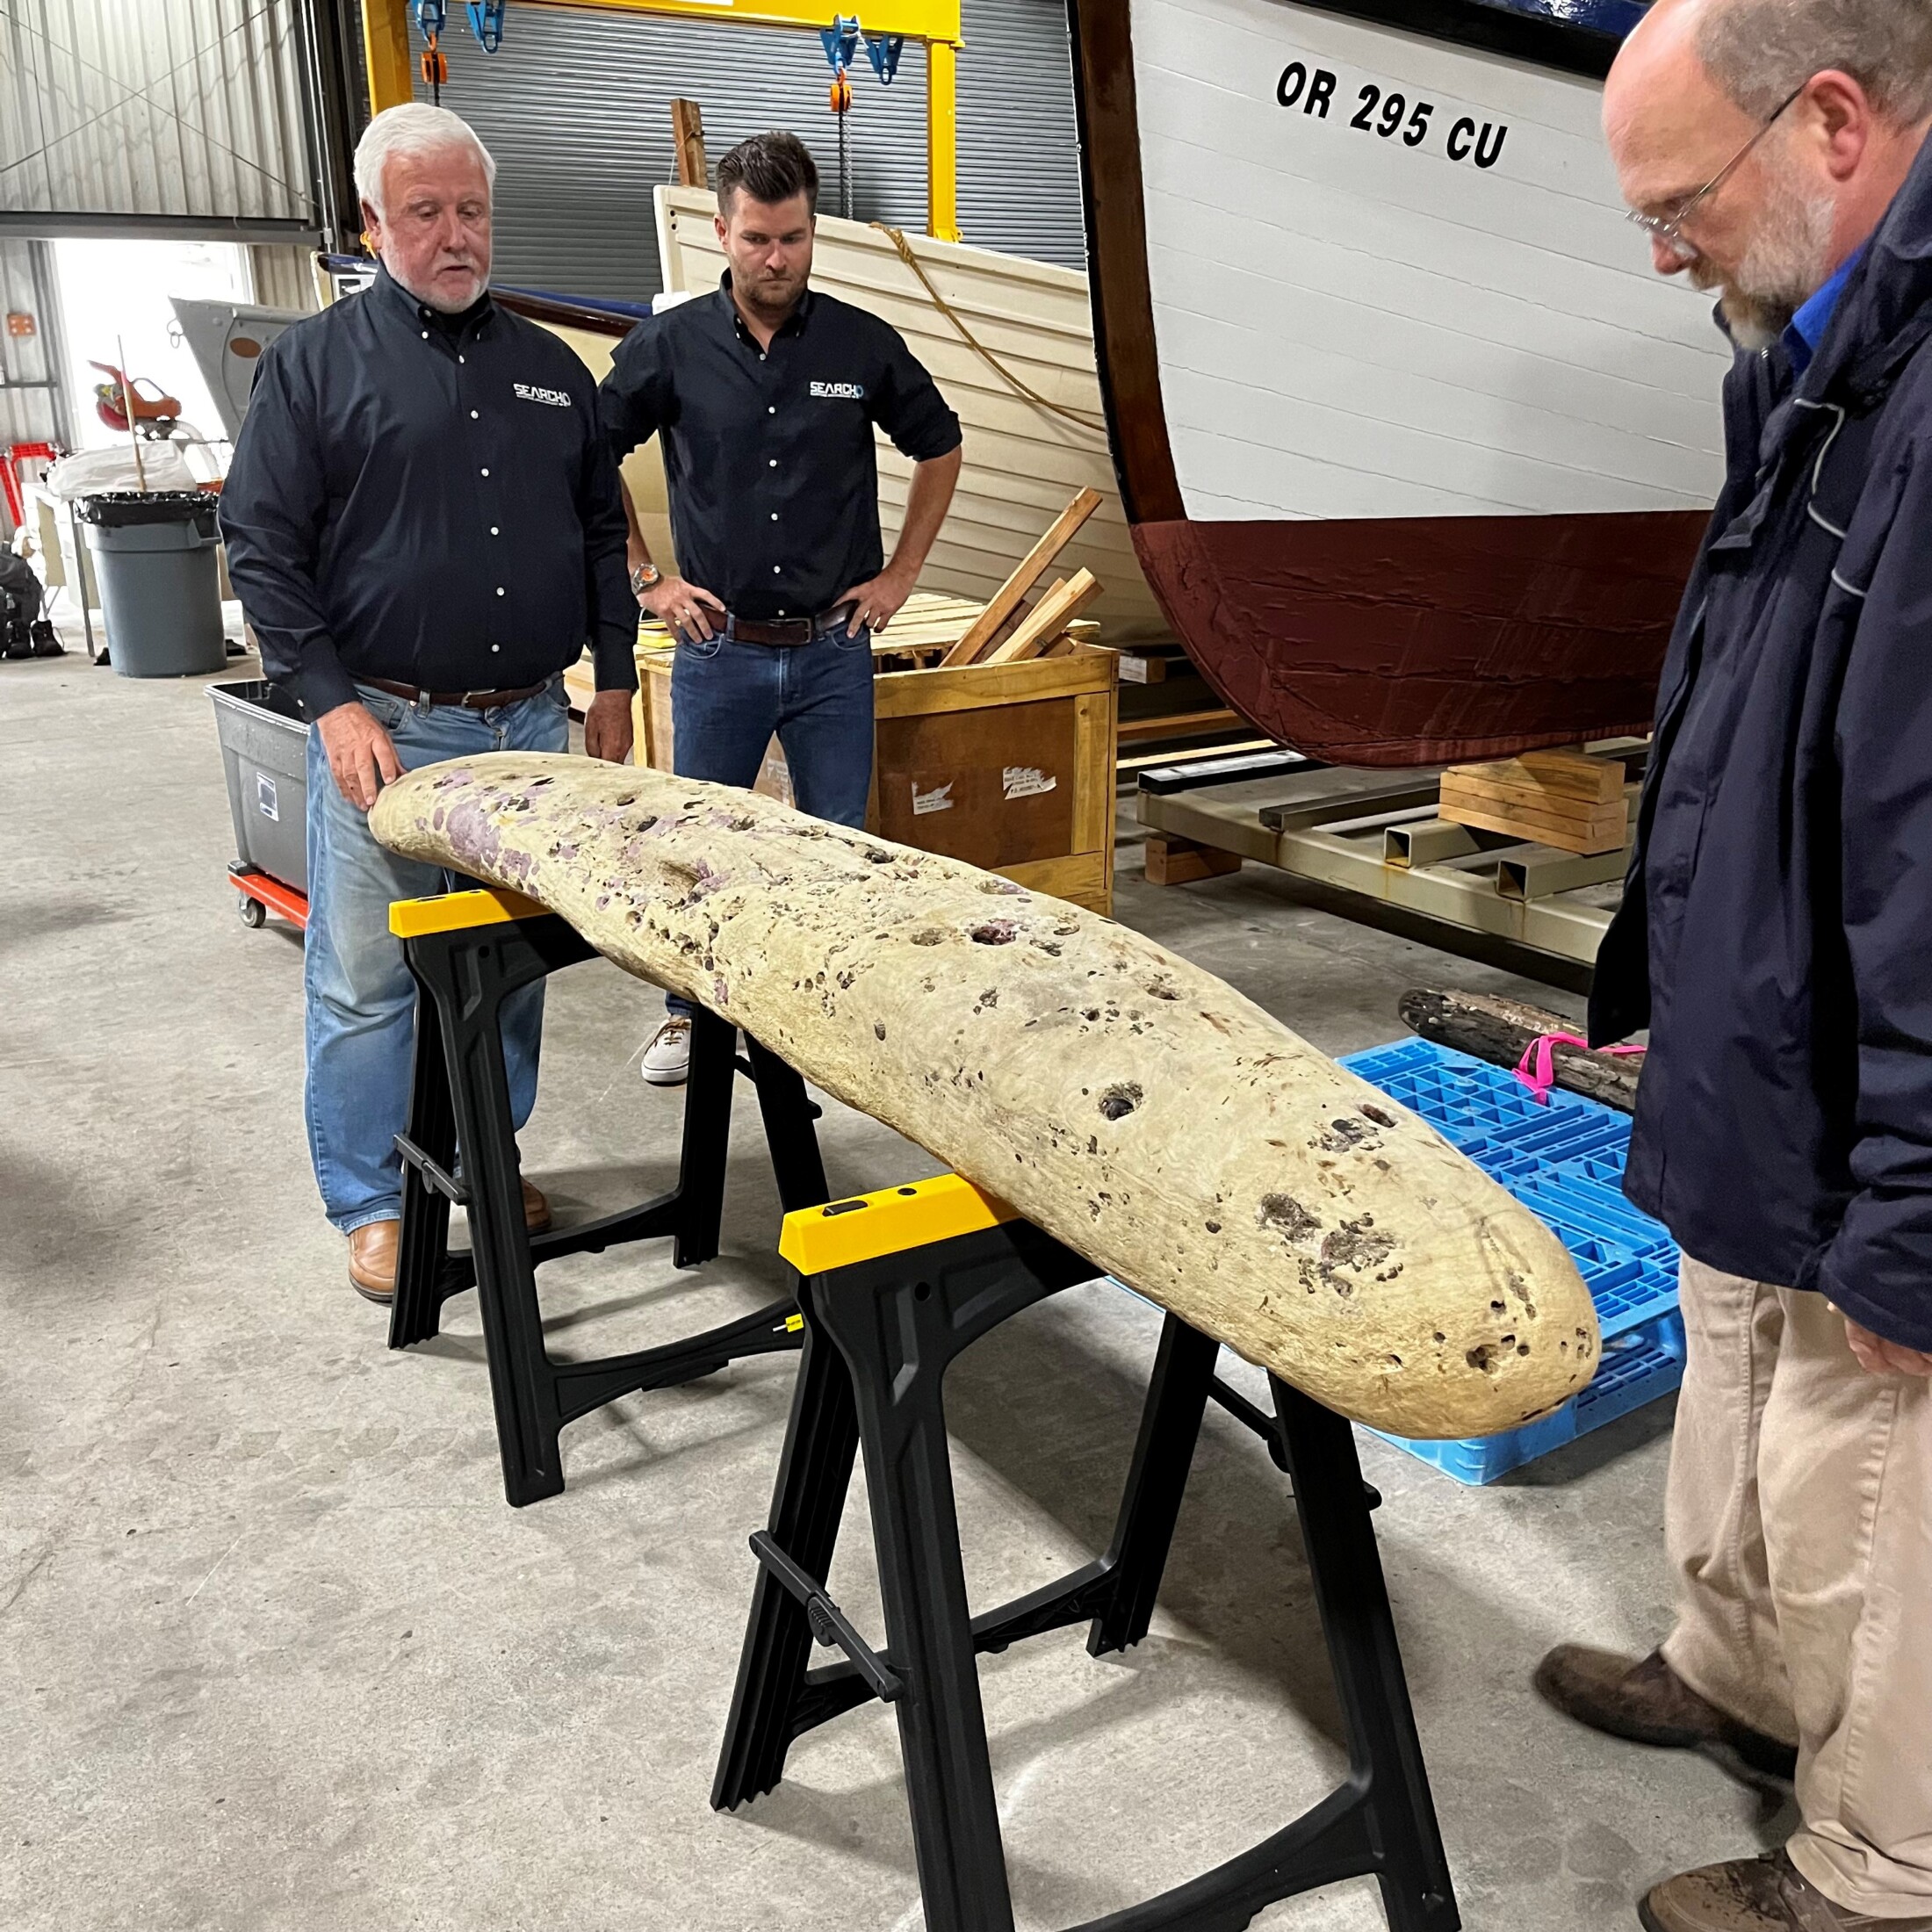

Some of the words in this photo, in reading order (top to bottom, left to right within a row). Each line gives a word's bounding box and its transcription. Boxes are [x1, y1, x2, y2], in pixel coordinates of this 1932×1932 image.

[1276, 61, 1337, 119] OR
[1350, 84, 1434, 147] 295
[1447, 117, 1508, 169] CU
